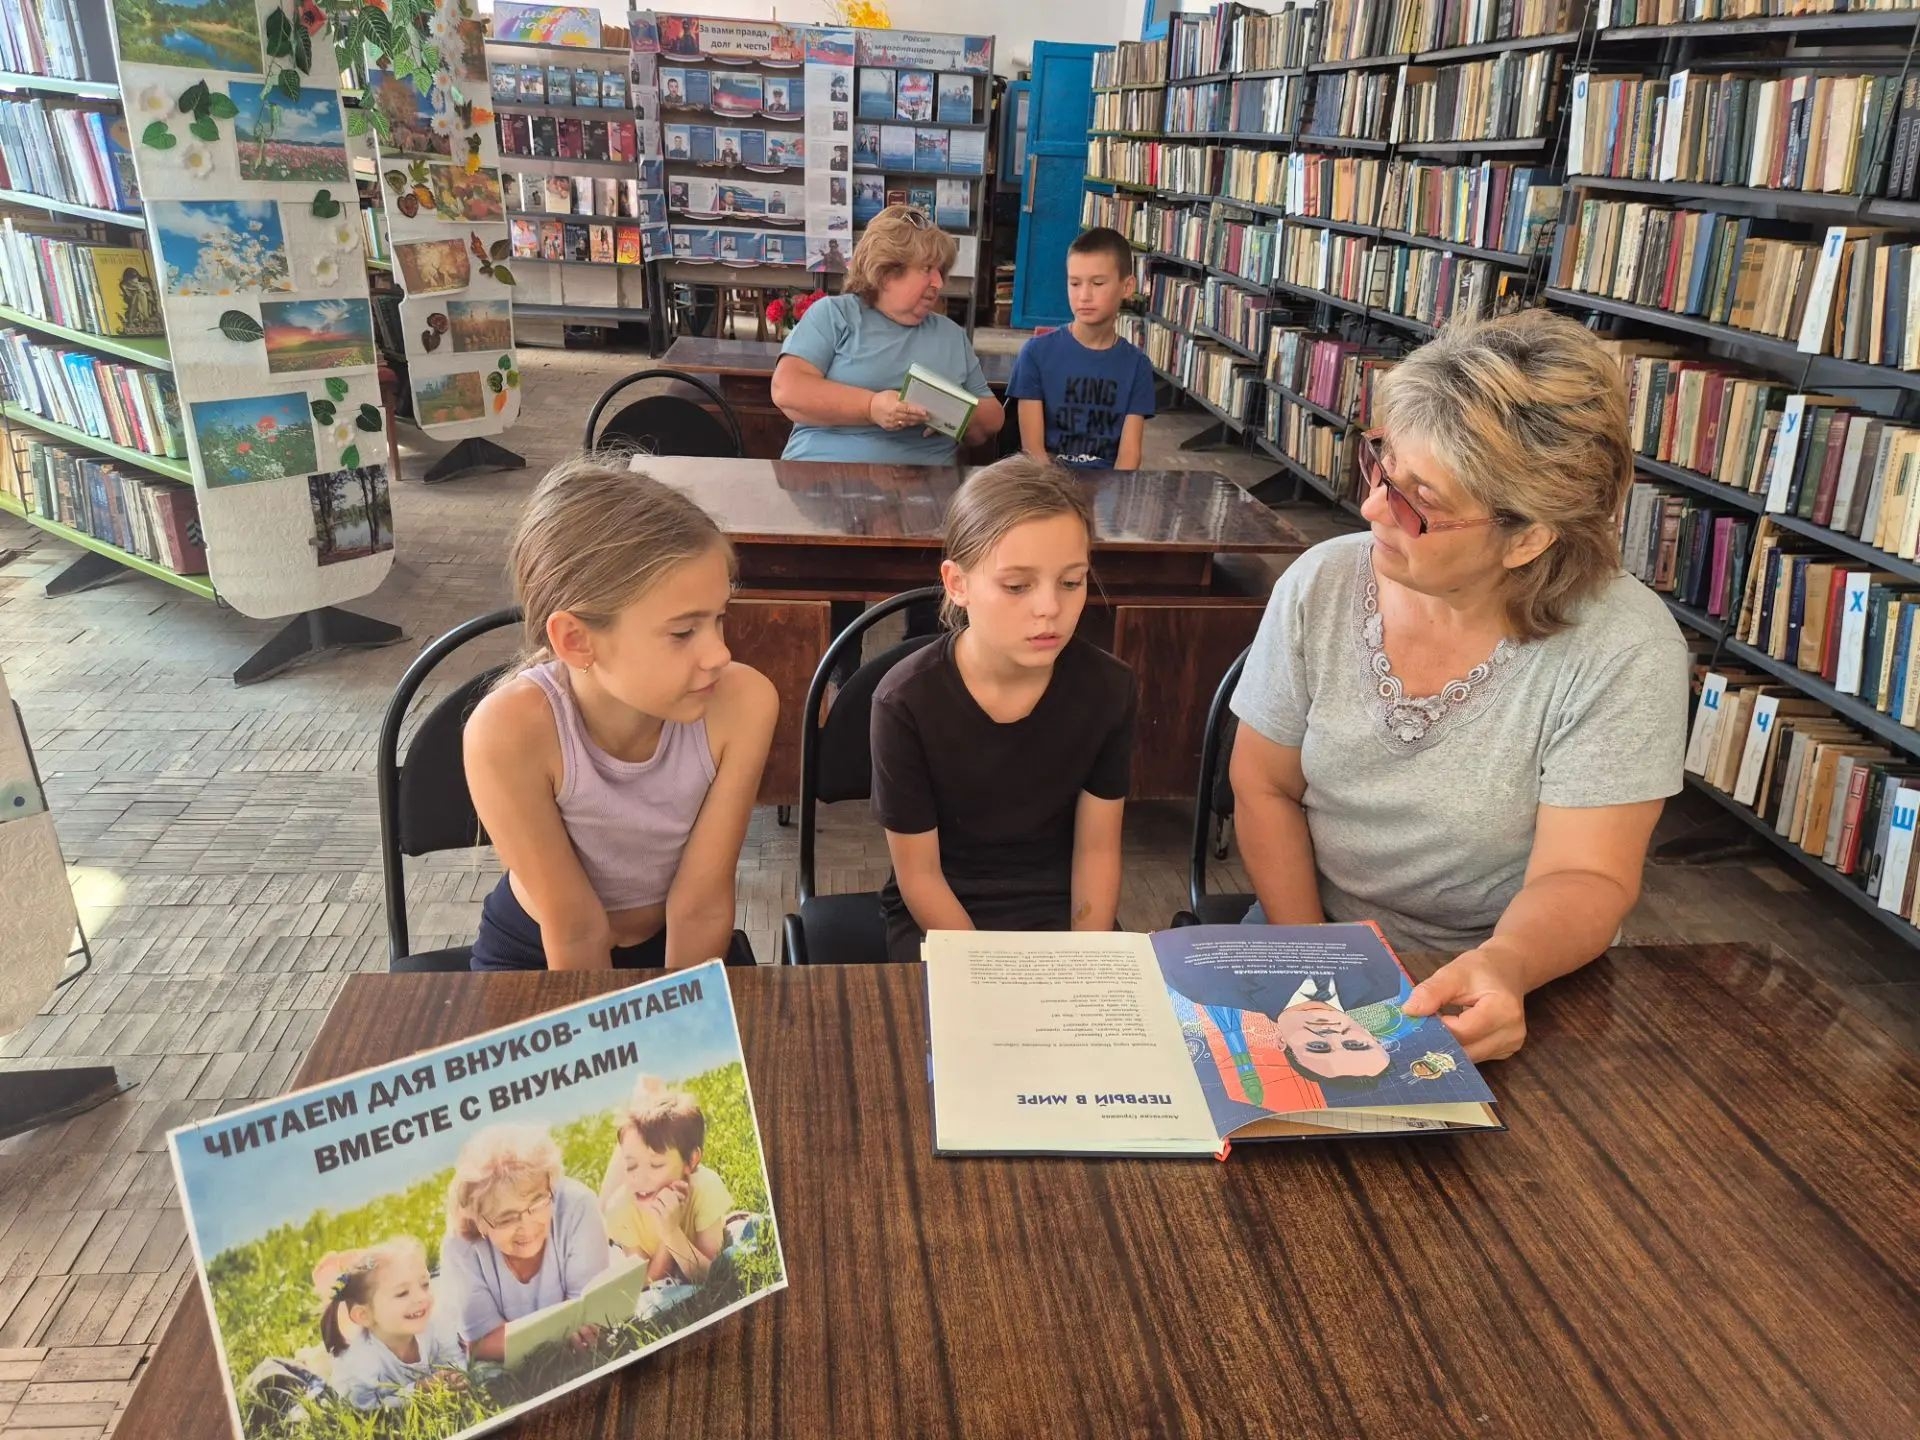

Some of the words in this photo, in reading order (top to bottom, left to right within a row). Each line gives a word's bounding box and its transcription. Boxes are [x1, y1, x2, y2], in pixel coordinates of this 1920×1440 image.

[699, 25, 709, 33] За
[711, 27, 734, 35] вами
[736, 28, 770, 38] правда,
[711, 40, 731, 49] долг
[744, 43, 770, 51] честь!
[1828, 235, 1842, 258] Т
[1064, 377, 1118, 407] KING
[1056, 405, 1084, 434] OF
[1086, 407, 1120, 436] MY
[1785, 412, 1799, 433] У
[1849, 591, 1865, 613] Х
[1704, 688, 1720, 711] Ц
[1756, 712, 1771, 733] Ч
[1892, 806, 1916, 832] Ш
[314, 1106, 453, 1174] ВМЕСТЕ
[460, 1095, 483, 1121] С
[490, 1041, 640, 1112] ВНУКАМИ
[1017, 1094, 1068, 1105] МИРЕ
[1076, 1094, 1087, 1105] В
[1094, 1094, 1172, 1107] ПЕРВЫЙ
[203, 1092, 359, 1159] ЧИТАЕМ
[367, 1063, 436, 1114] ДЛЯ
